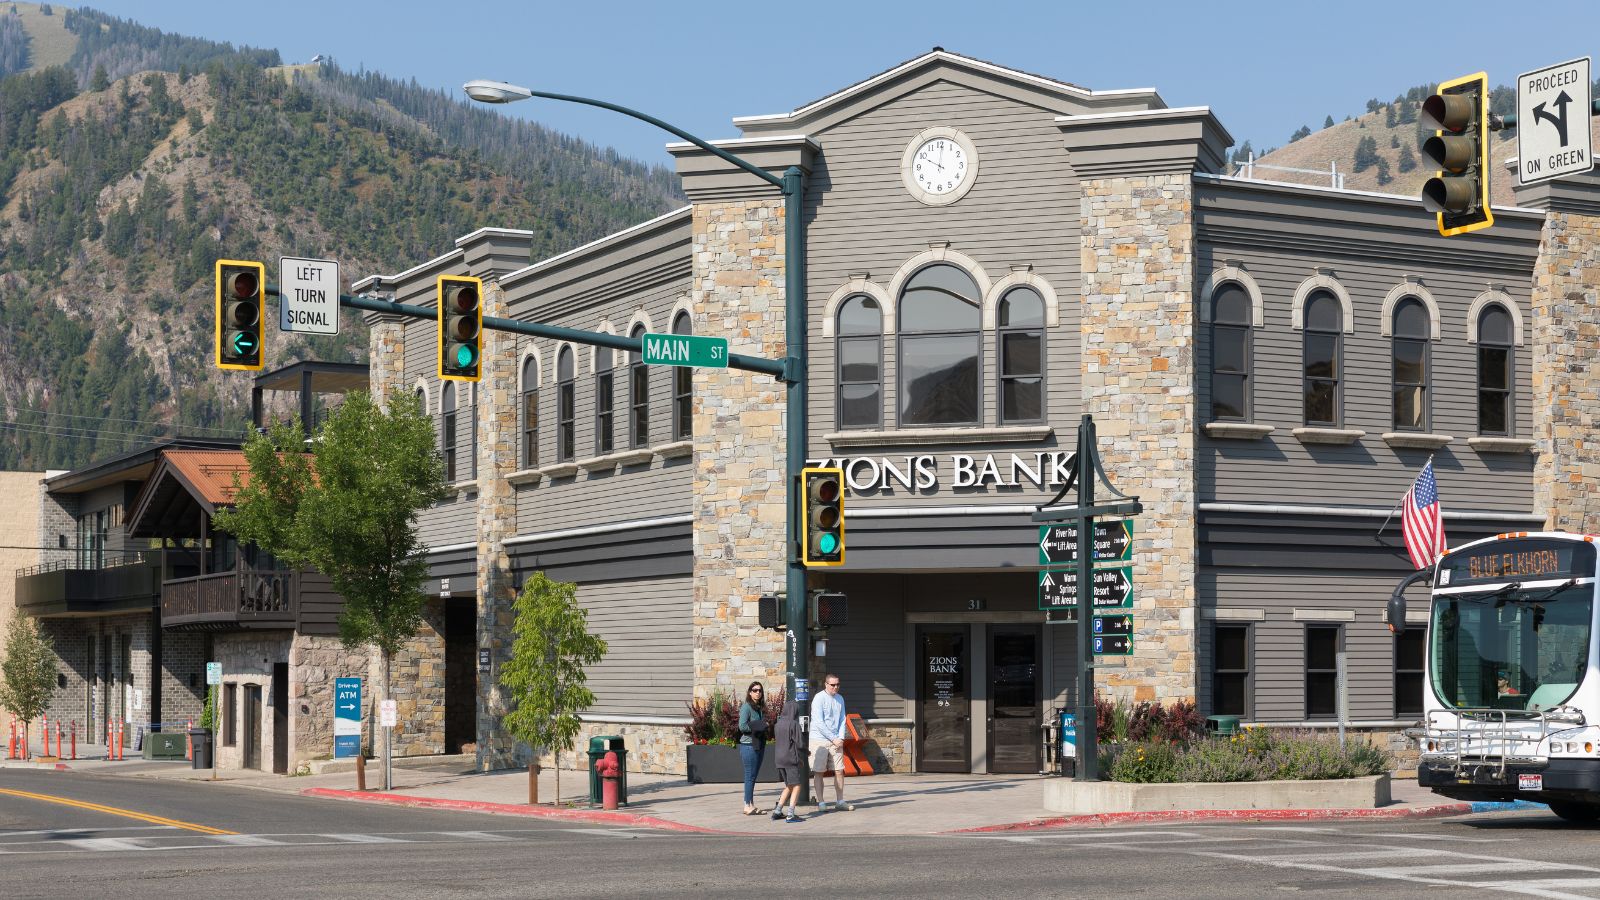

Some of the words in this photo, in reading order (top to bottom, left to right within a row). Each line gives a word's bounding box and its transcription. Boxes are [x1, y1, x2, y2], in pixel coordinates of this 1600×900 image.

[1529, 70, 1578, 94] PROCEED
[1527, 158, 1541, 174] ON
[1548, 149, 1584, 169] GREEN
[297, 266, 323, 282] LEFT
[294, 288, 326, 304] TURN
[287, 310, 330, 326] SIGNAL
[647, 338, 690, 362] MAIN
[710, 345, 724, 360] ST
[951, 451, 1079, 488] BANK
[1055, 528, 1067, 538] River
[1068, 528, 1078, 537] Run
[1094, 527, 1107, 536] Town
[1057, 541, 1066, 551] Lift
[1066, 541, 1078, 551] Area
[1094, 540, 1110, 550] Square
[1469, 554, 1500, 578] BLUE
[1503, 550, 1558, 576] ELKHORN
[1064, 574, 1076, 582] Warm
[1093, 573, 1102, 583] Sun
[1103, 572, 1118, 583] Valley
[1059, 584, 1077, 596] Springs
[1093, 586, 1110, 596] Resort
[1051, 595, 1061, 605] Lift
[1061, 596, 1072, 605] Area
[929, 656, 958, 665] ZIONS
[929, 665, 958, 674] BANK
[339, 691, 357, 699] ATM
